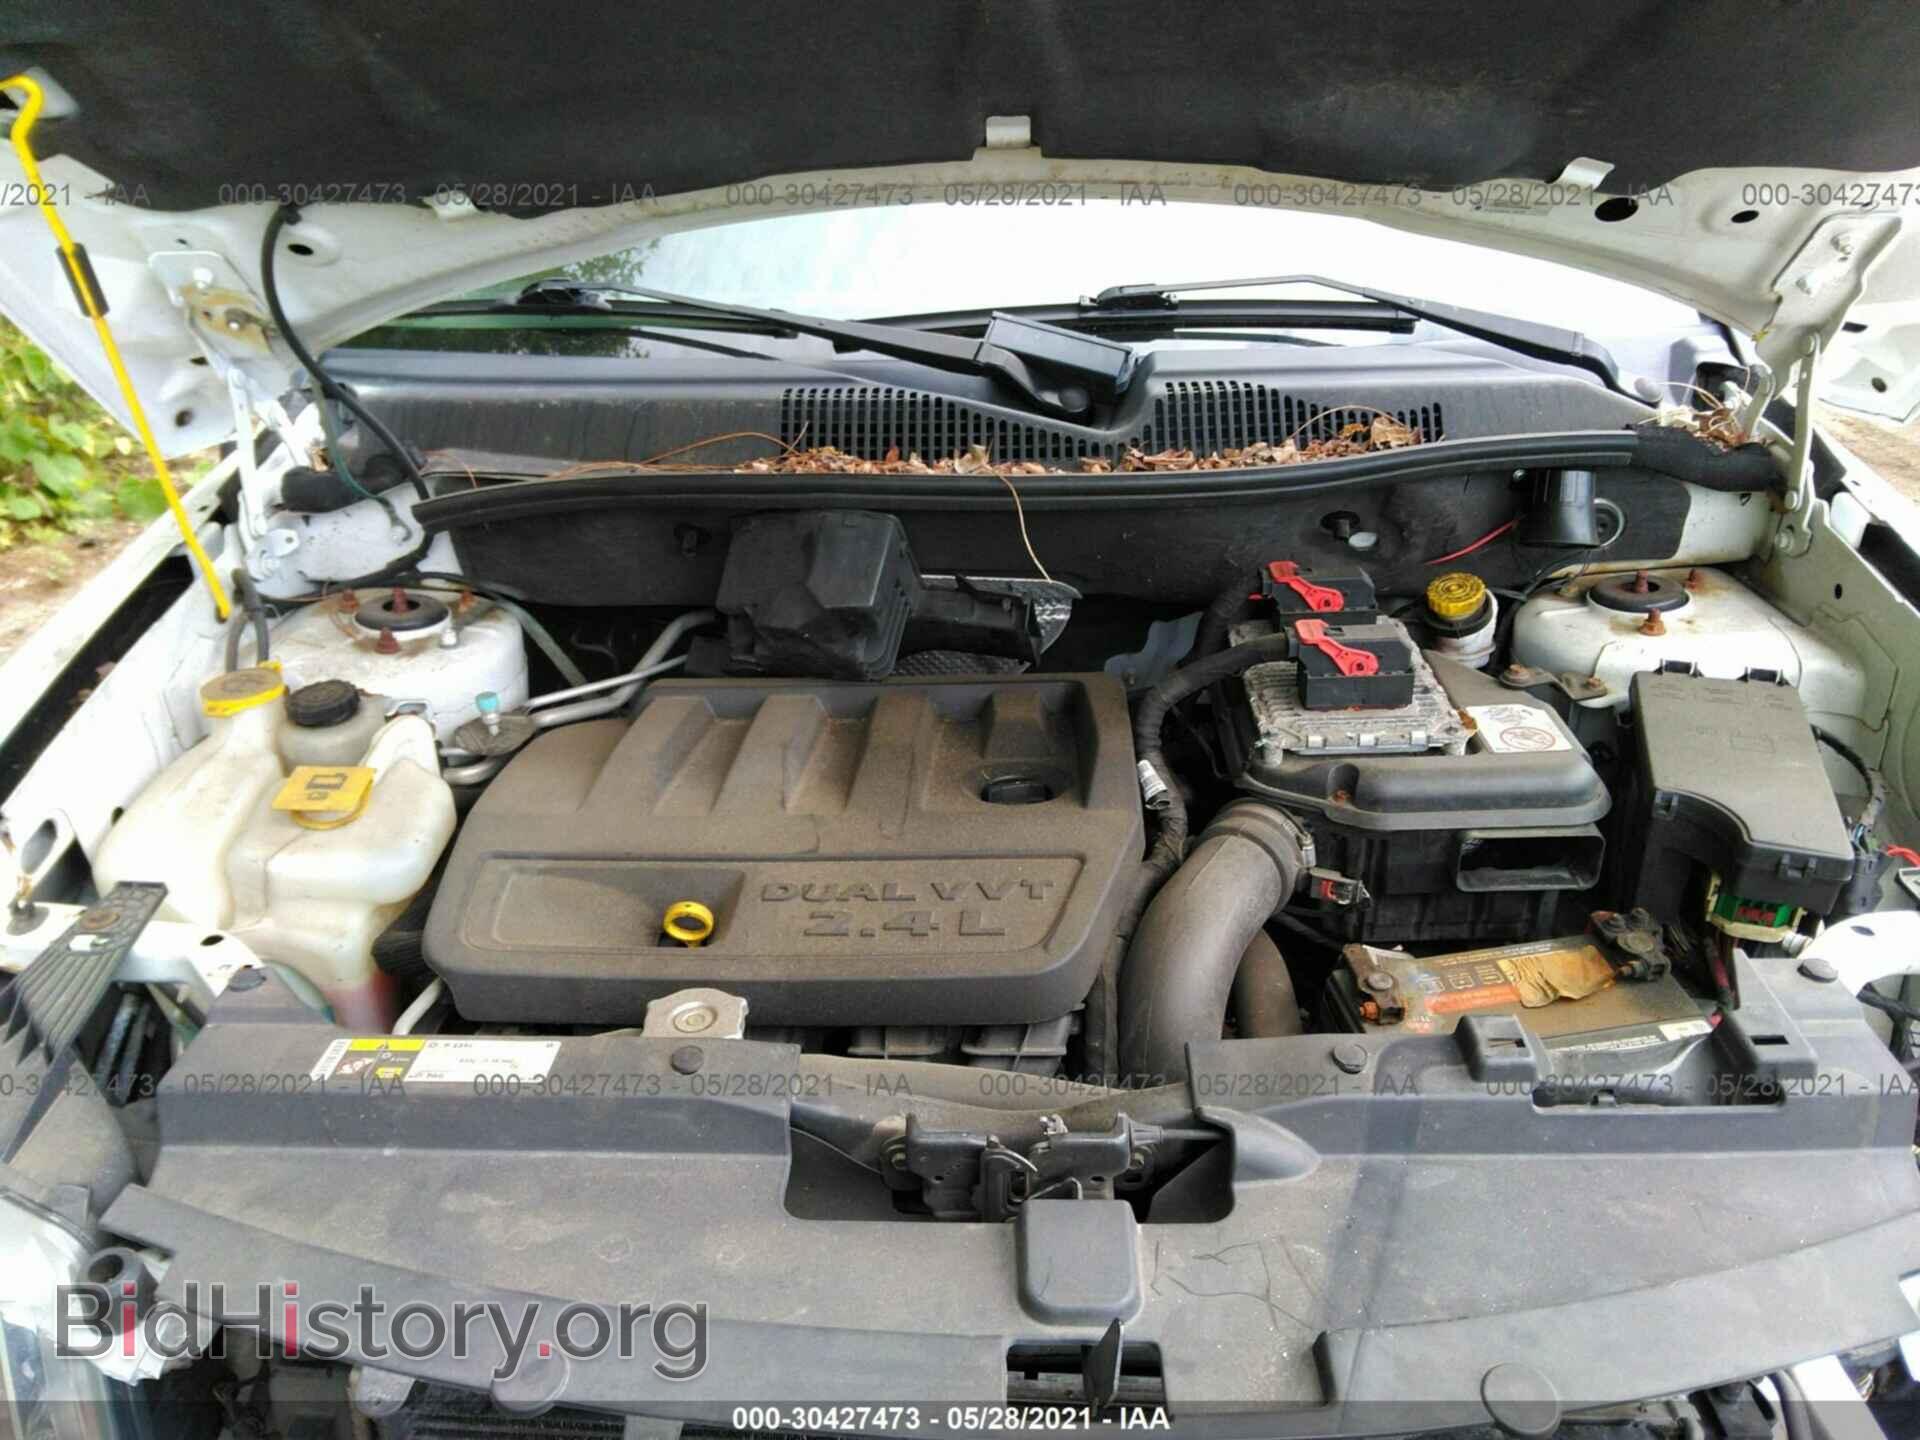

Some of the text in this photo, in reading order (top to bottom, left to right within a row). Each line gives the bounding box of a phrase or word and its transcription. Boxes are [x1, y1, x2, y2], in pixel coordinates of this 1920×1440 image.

[760, 879, 1054, 902] DUAL VVT
[803, 909, 1006, 937] 2.4L
